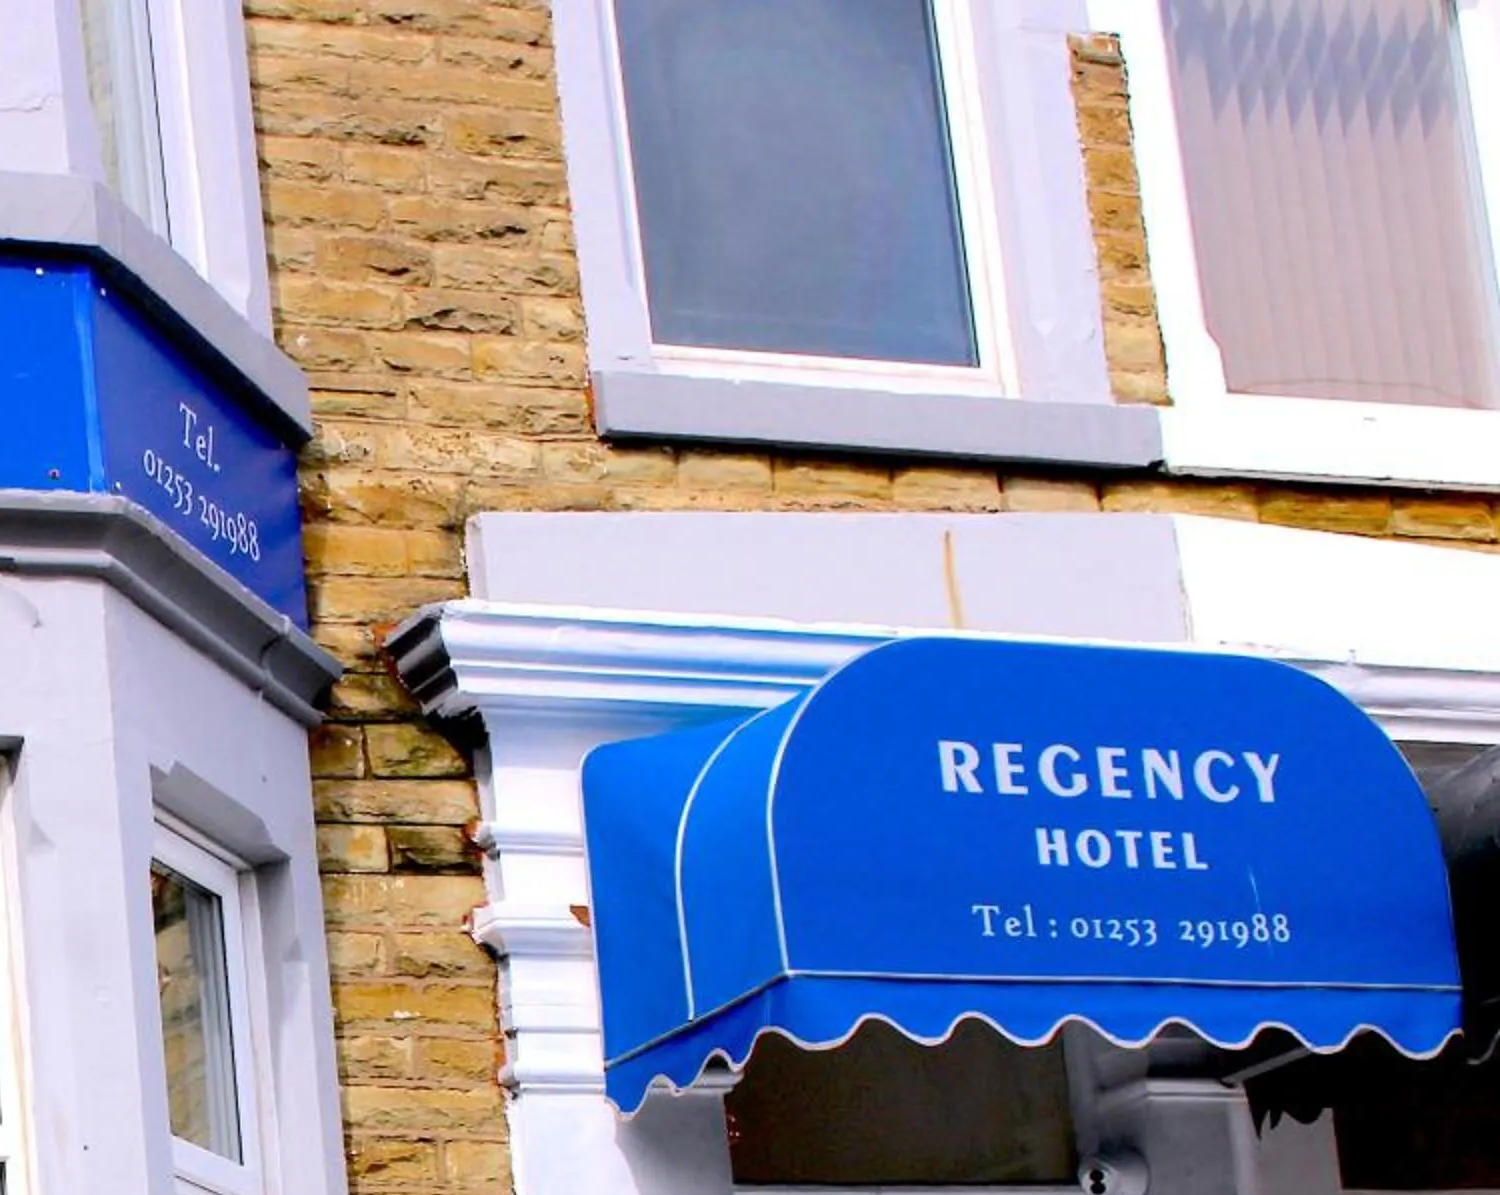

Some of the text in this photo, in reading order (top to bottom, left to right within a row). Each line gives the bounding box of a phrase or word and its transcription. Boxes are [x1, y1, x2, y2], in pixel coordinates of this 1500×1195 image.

[179, 402, 220, 472] Tel.
[143, 449, 260, 562] 01253 291988
[938, 740, 1279, 803] REGENCY
[1036, 828, 1209, 870] HOTEL
[1070, 918, 1158, 947] 01253
[1179, 913, 1291, 949] 291988
